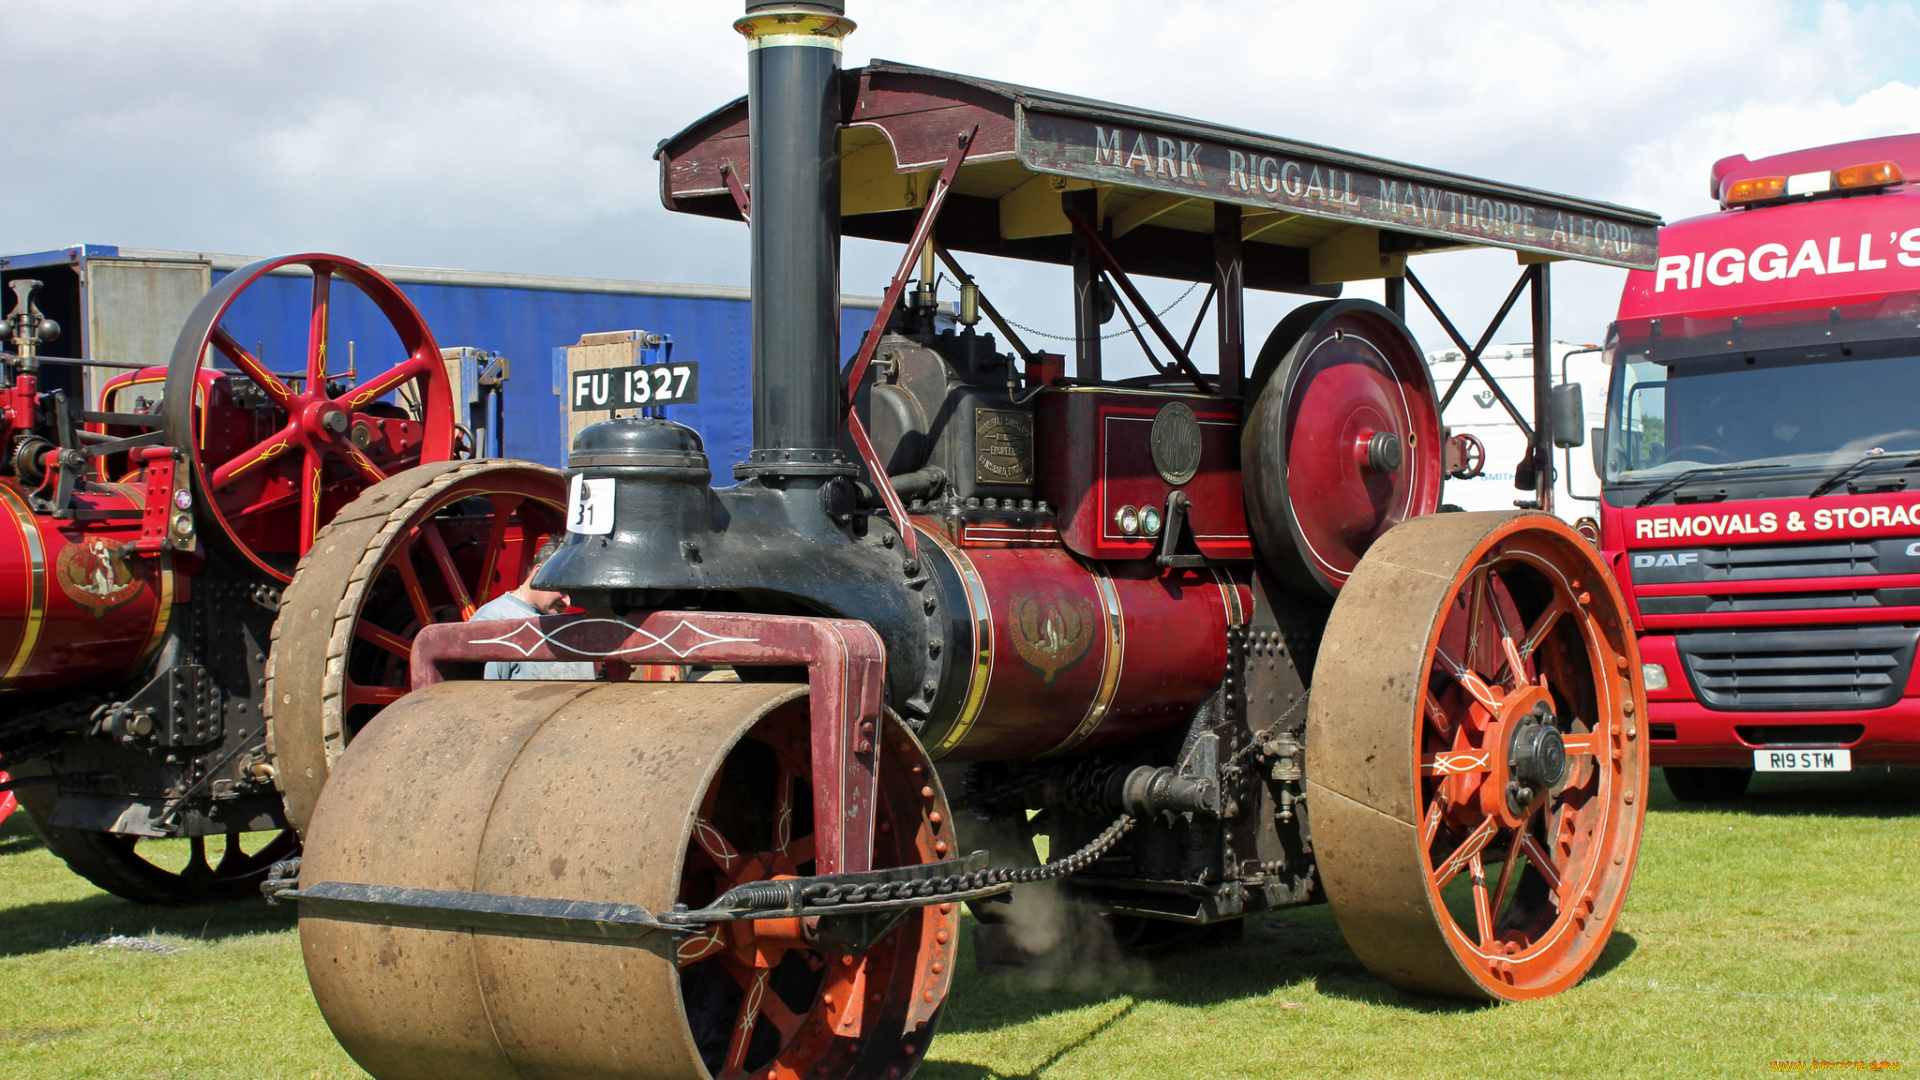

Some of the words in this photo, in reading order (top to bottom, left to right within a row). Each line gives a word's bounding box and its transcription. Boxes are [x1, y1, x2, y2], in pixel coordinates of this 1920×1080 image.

[1094, 125, 1203, 181] MARK
[1228, 149, 1360, 208] RIGGALL
[1378, 178, 1536, 238] MAWTHORPE
[1550, 211, 1634, 255] ALFORD
[1655, 227, 1920, 293] RIGGALL'S
[575, 372, 610, 406] FU
[624, 366, 692, 404] 1327
[1636, 512, 1778, 540] REMOVALS
[1786, 511, 1806, 531] &
[1634, 552, 1698, 568] DAF
[1770, 752, 1796, 768] R19
[1801, 751, 1834, 768] STM
